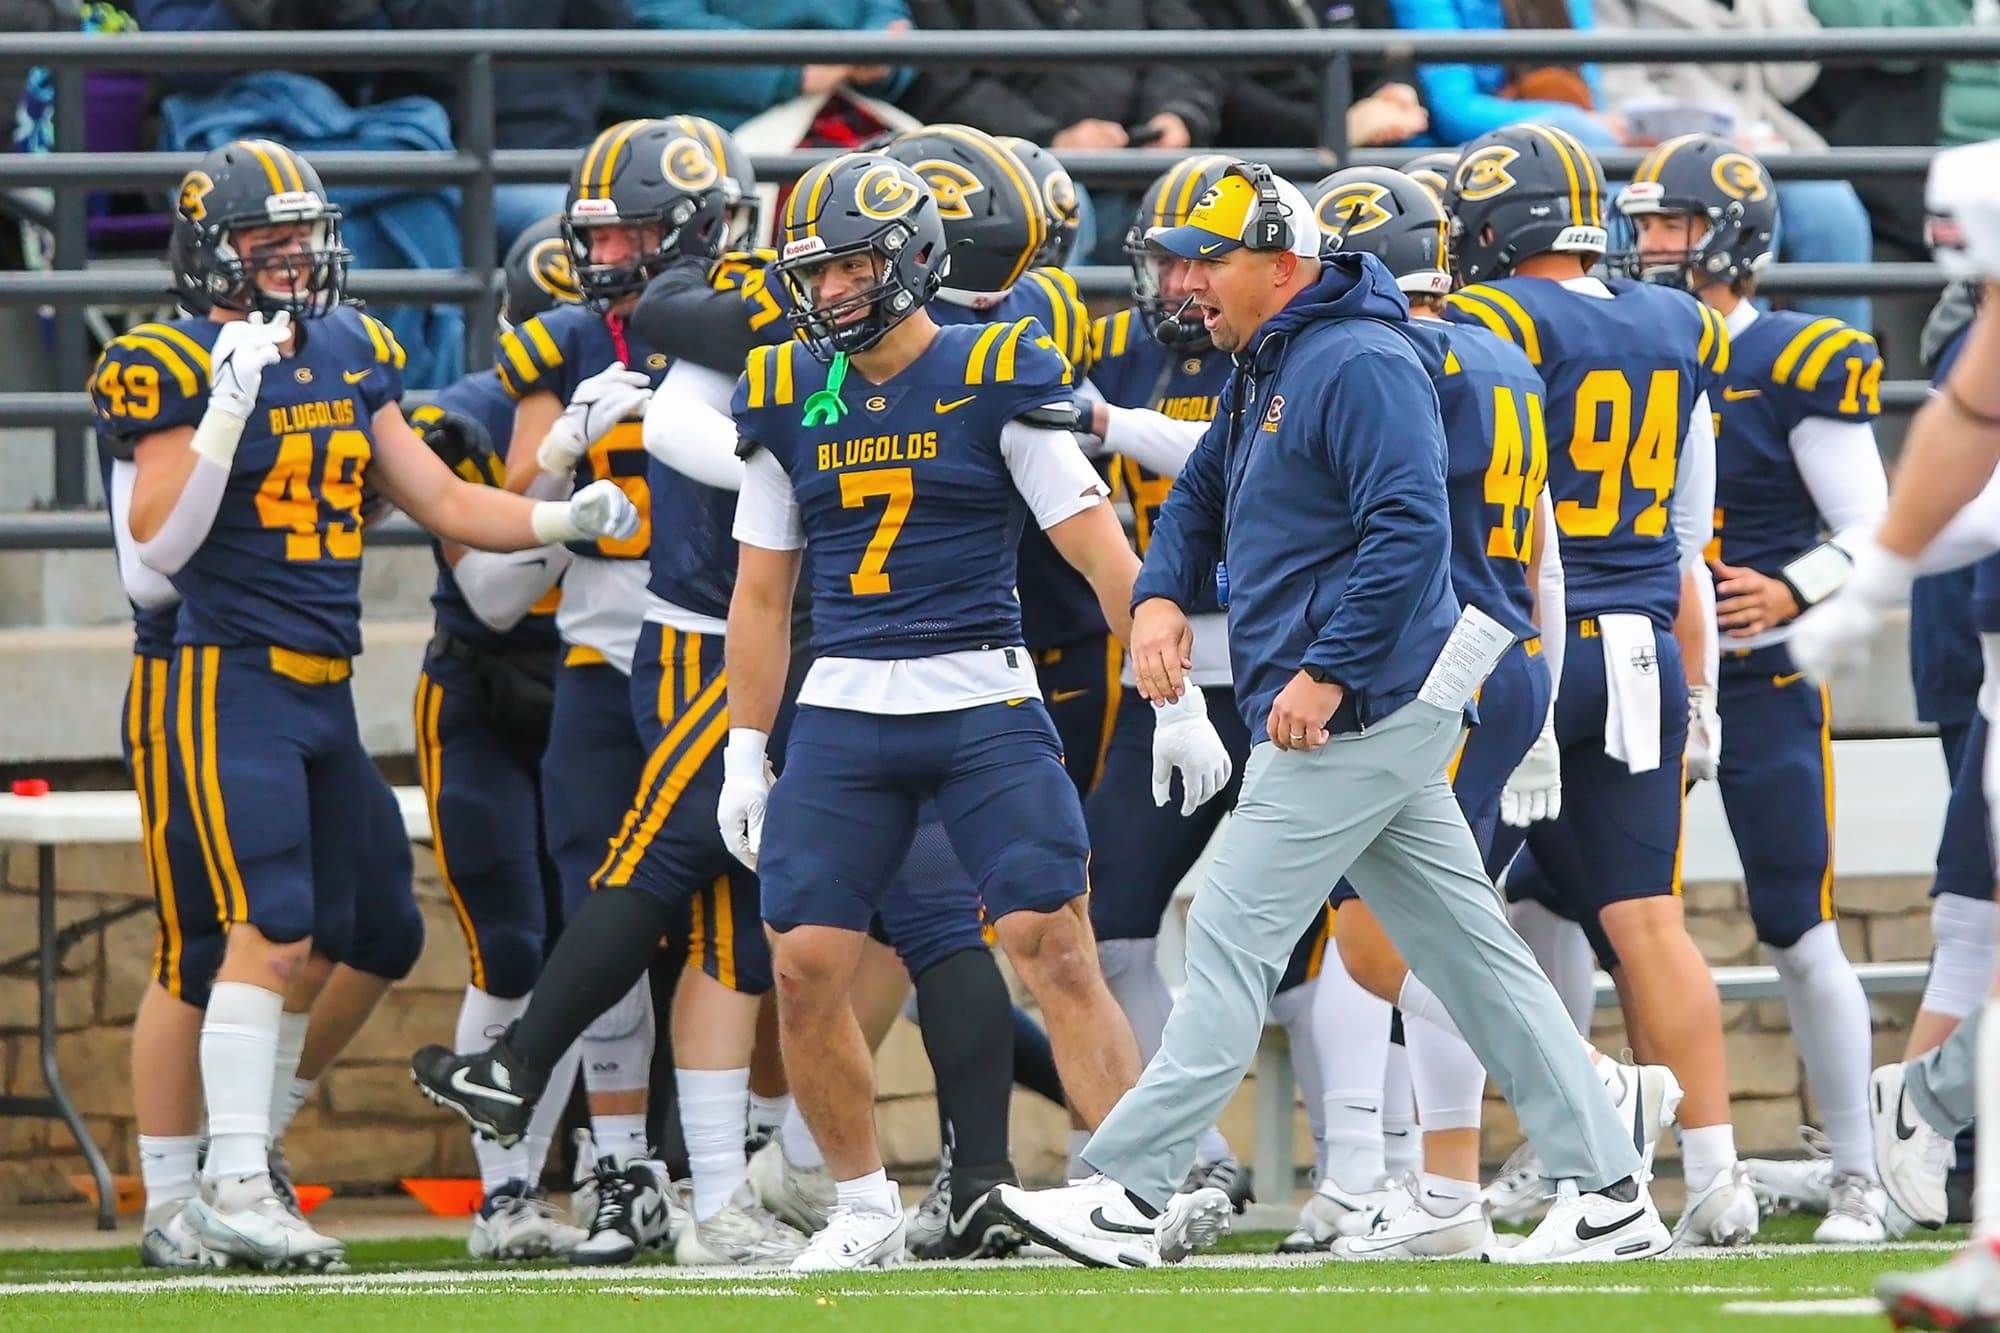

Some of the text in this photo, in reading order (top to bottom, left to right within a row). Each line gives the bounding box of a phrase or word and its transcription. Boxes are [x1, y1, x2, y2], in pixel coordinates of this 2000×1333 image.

[1266, 223, 1280, 242] P
[98, 360, 160, 420] 49
[1837, 356, 1884, 415] 14
[817, 430, 938, 472] BLUGOLDS
[1555, 369, 1680, 538] 94
[255, 429, 372, 562] 49
[838, 466, 914, 596] 7
